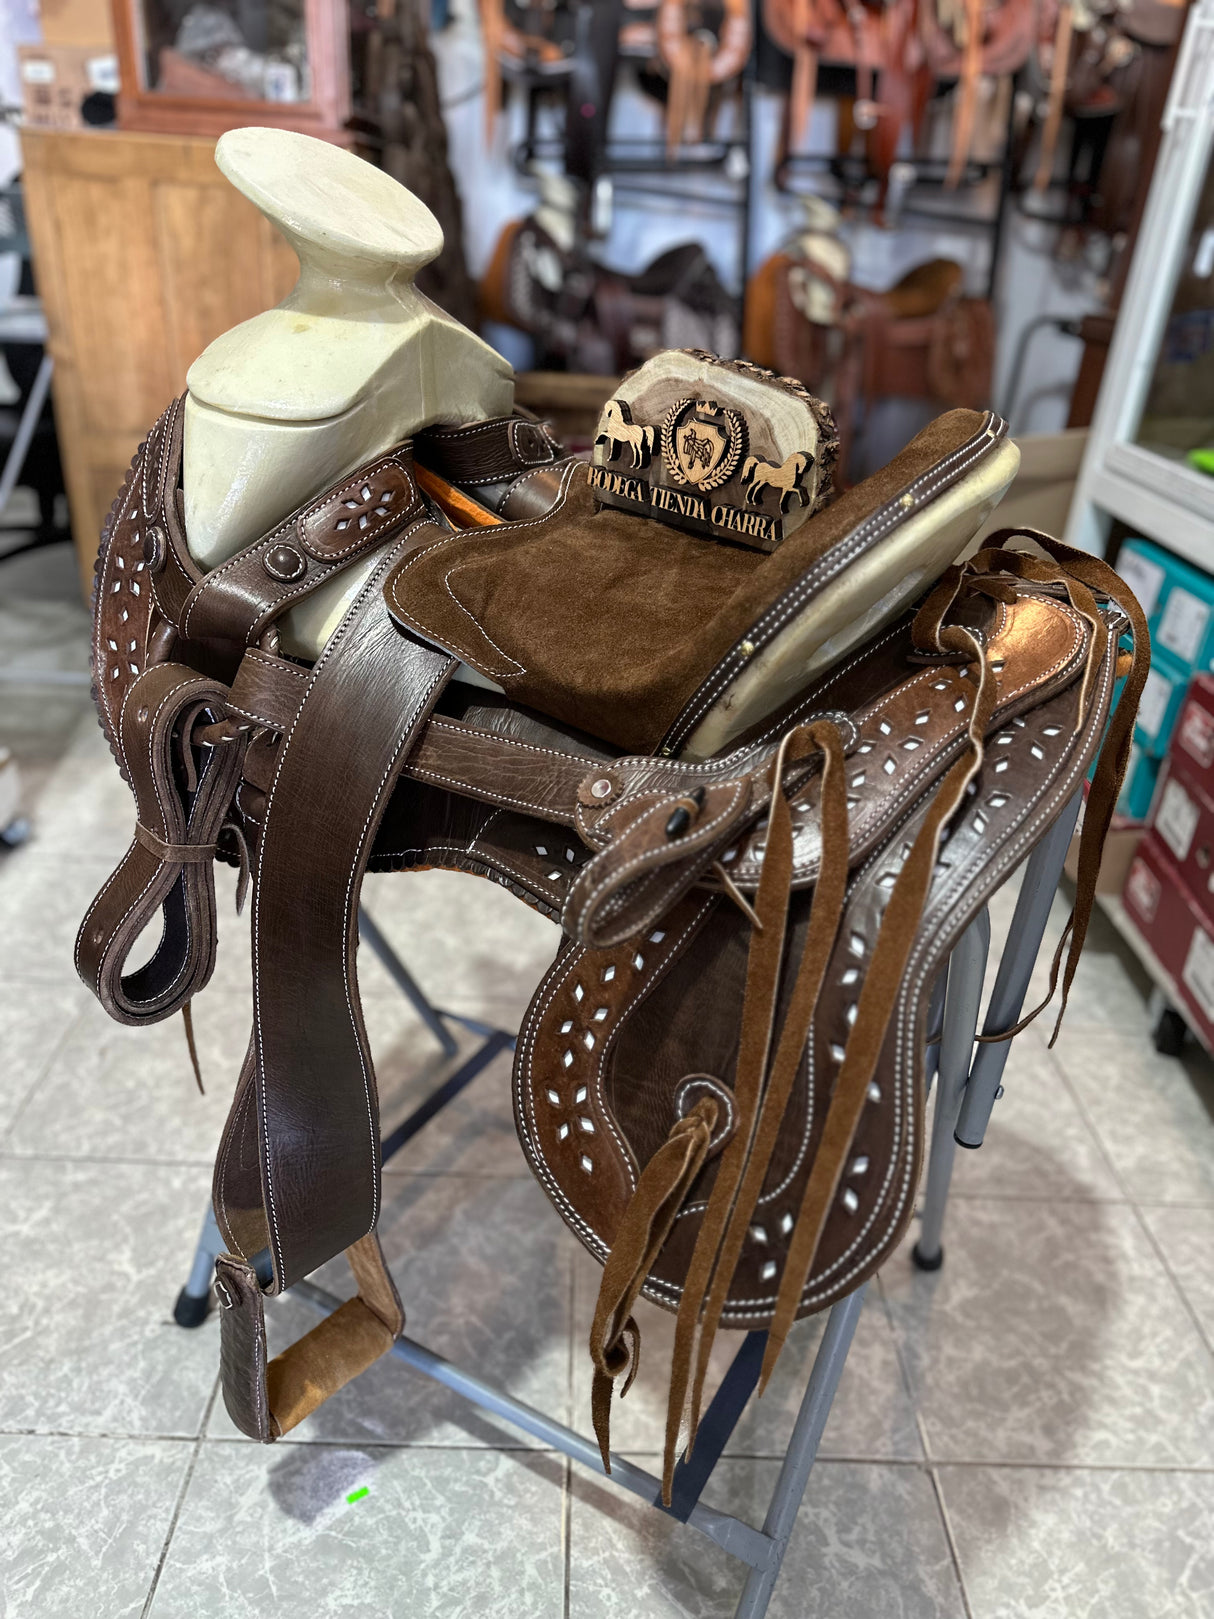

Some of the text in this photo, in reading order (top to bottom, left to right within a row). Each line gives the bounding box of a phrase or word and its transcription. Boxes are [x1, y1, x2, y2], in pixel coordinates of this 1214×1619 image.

[588, 467, 777, 541] BODEGA TIENDA CHARRA
